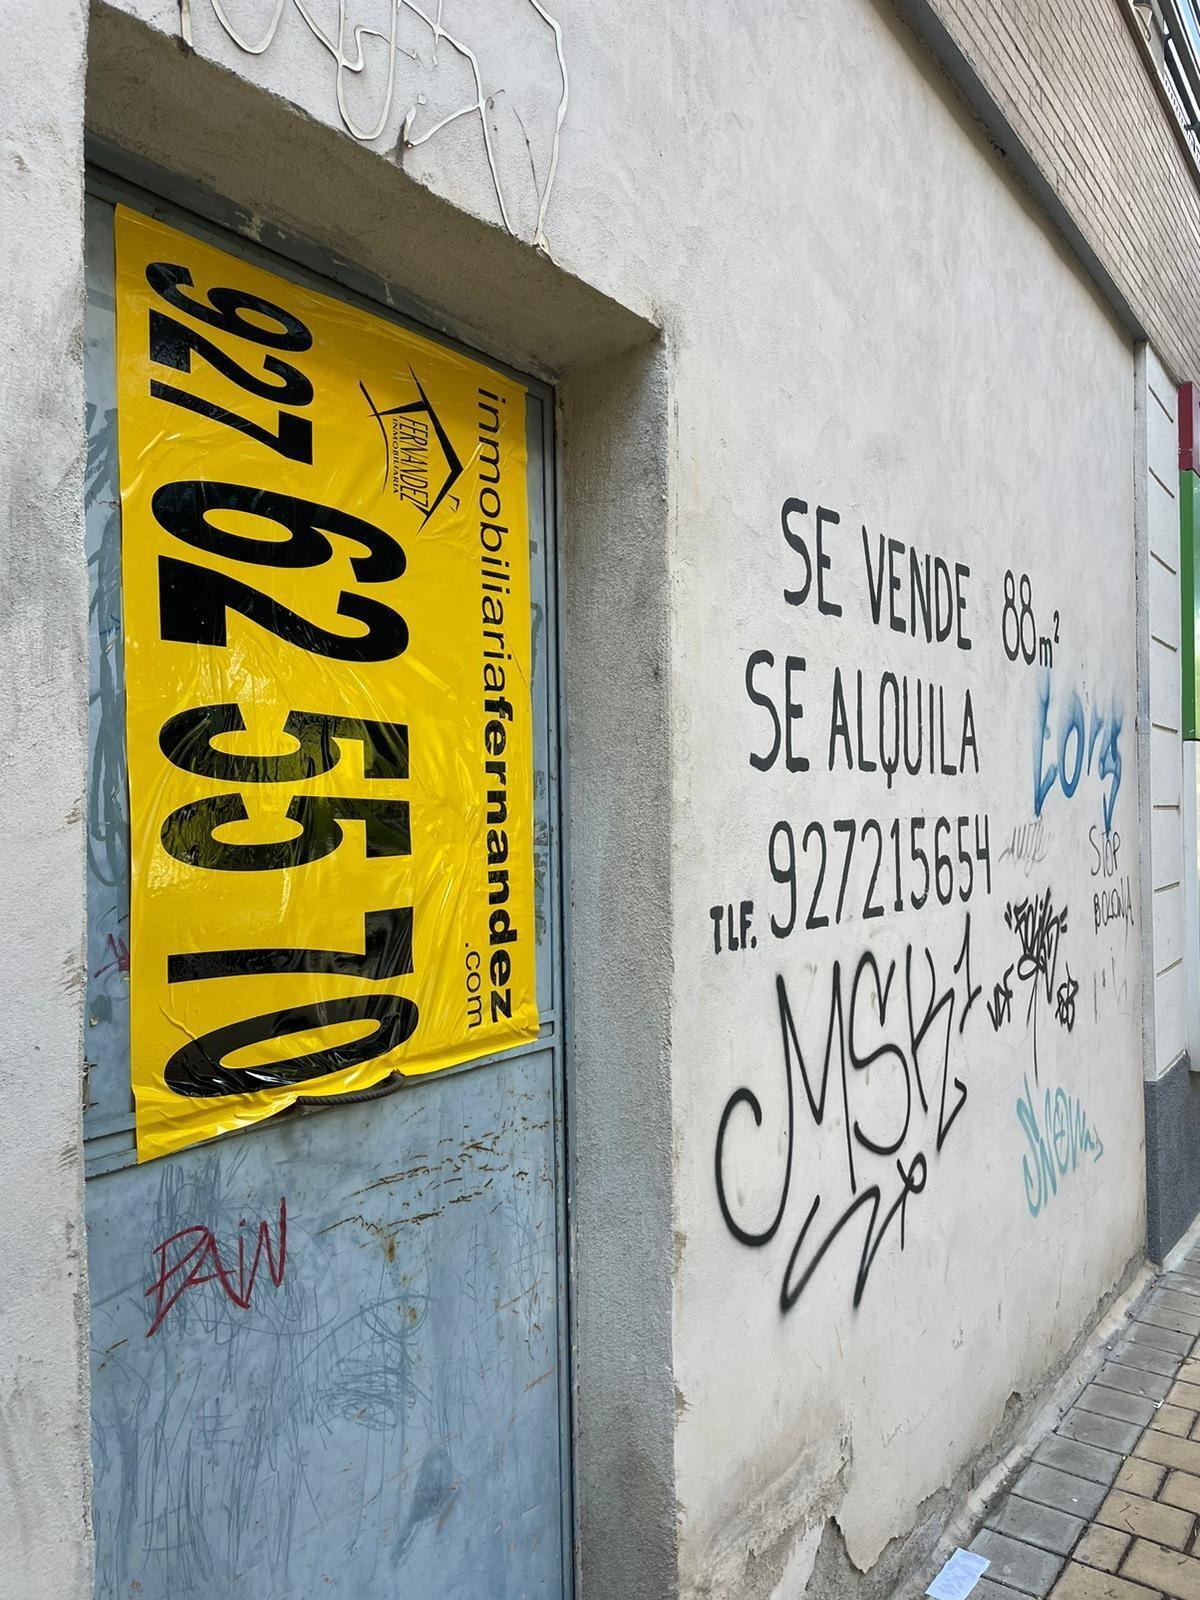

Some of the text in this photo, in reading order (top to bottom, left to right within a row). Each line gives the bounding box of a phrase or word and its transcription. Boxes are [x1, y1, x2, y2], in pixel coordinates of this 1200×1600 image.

[393, 418, 401, 494] INMOBILIARIA
[400, 415, 429, 508] FERNANDEZ
[781, 497, 843, 618] SE
[861, 525, 972, 651] VENDE
[147, 262, 420, 1097] 927 62 55 70
[745, 649, 980, 789] SE ALQUILA
[709, 900, 757, 955] TLF.
[768, 814, 991, 938] 927215654
[1088, 824, 1121, 878] STOP
[465, 942, 482, 1029] .com
